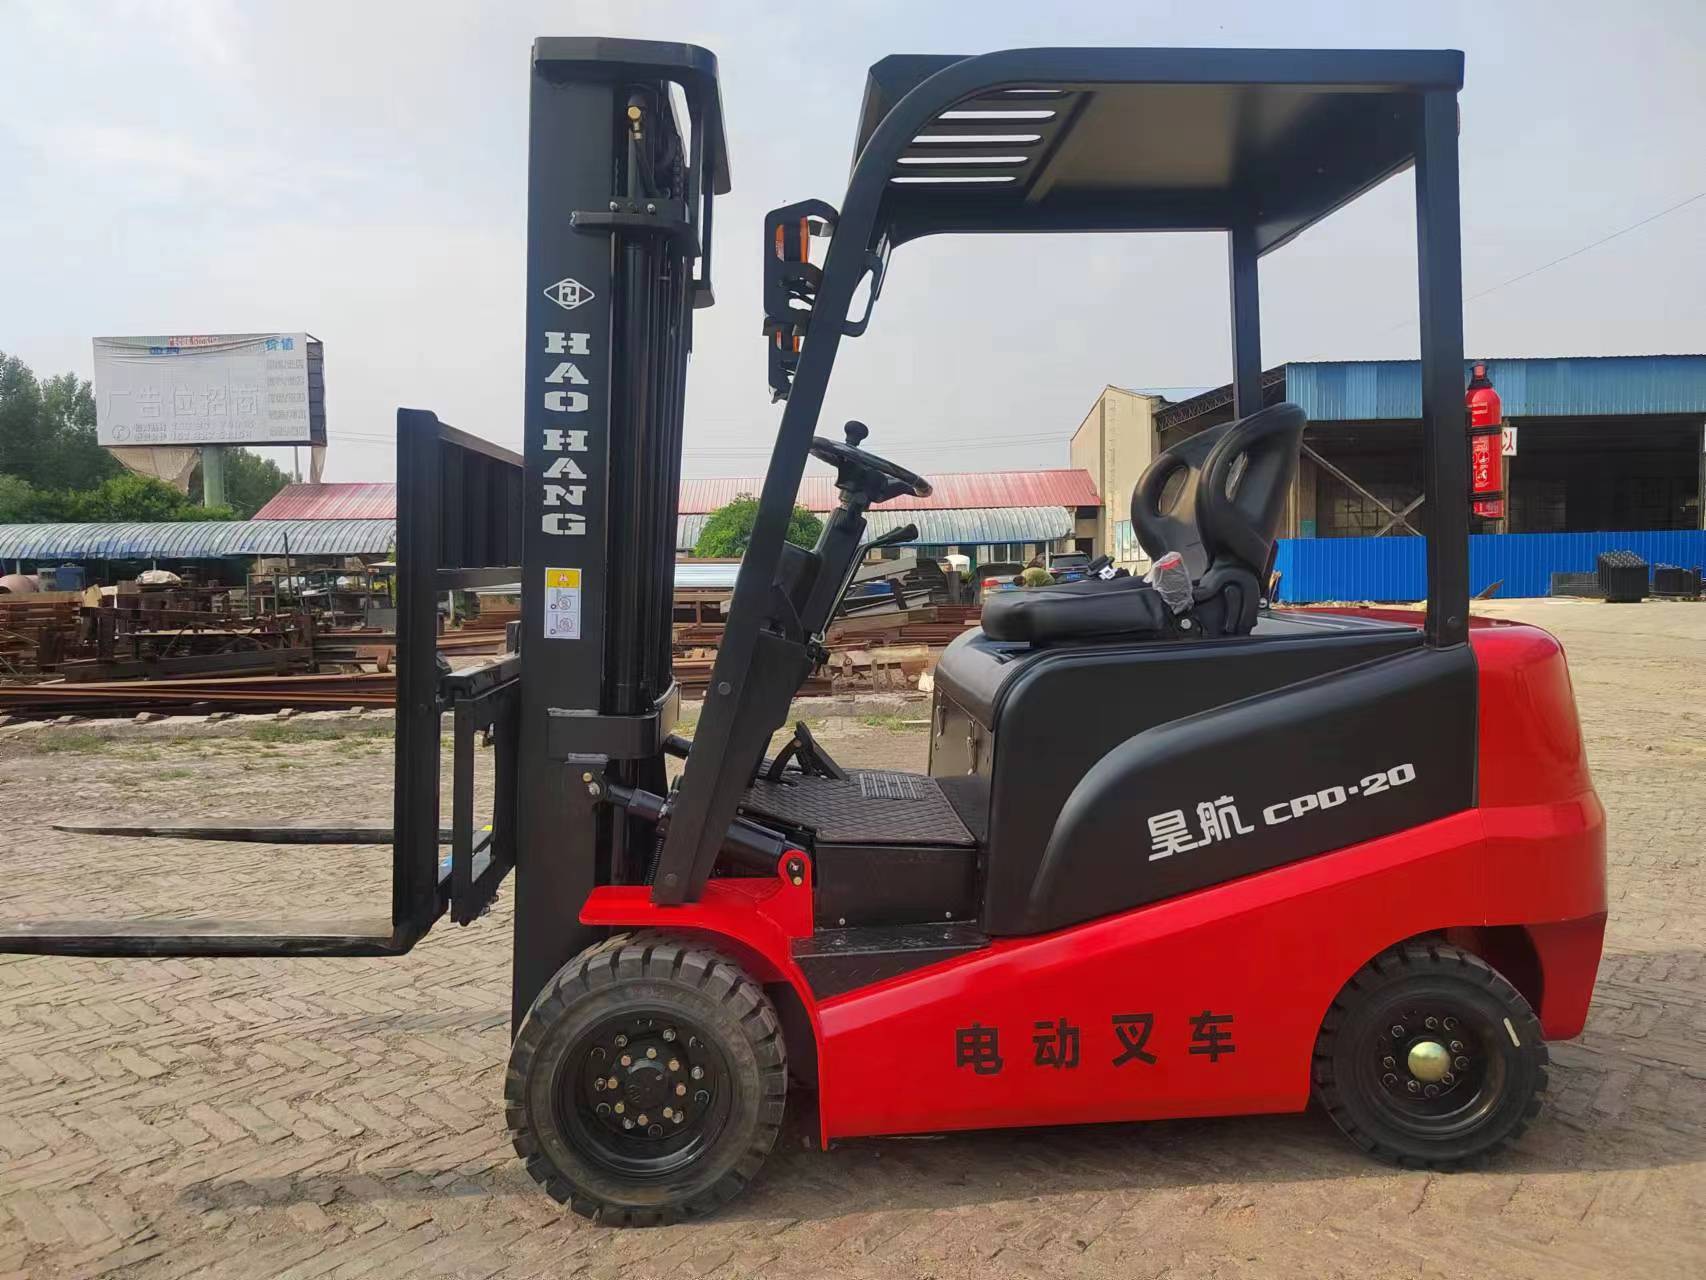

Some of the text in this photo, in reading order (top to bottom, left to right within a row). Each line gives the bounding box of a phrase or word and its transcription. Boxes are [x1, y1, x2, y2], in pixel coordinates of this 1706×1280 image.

[1148, 796, 1254, 861] 昊航
[956, 1010, 1236, 1075] 电动叉车
